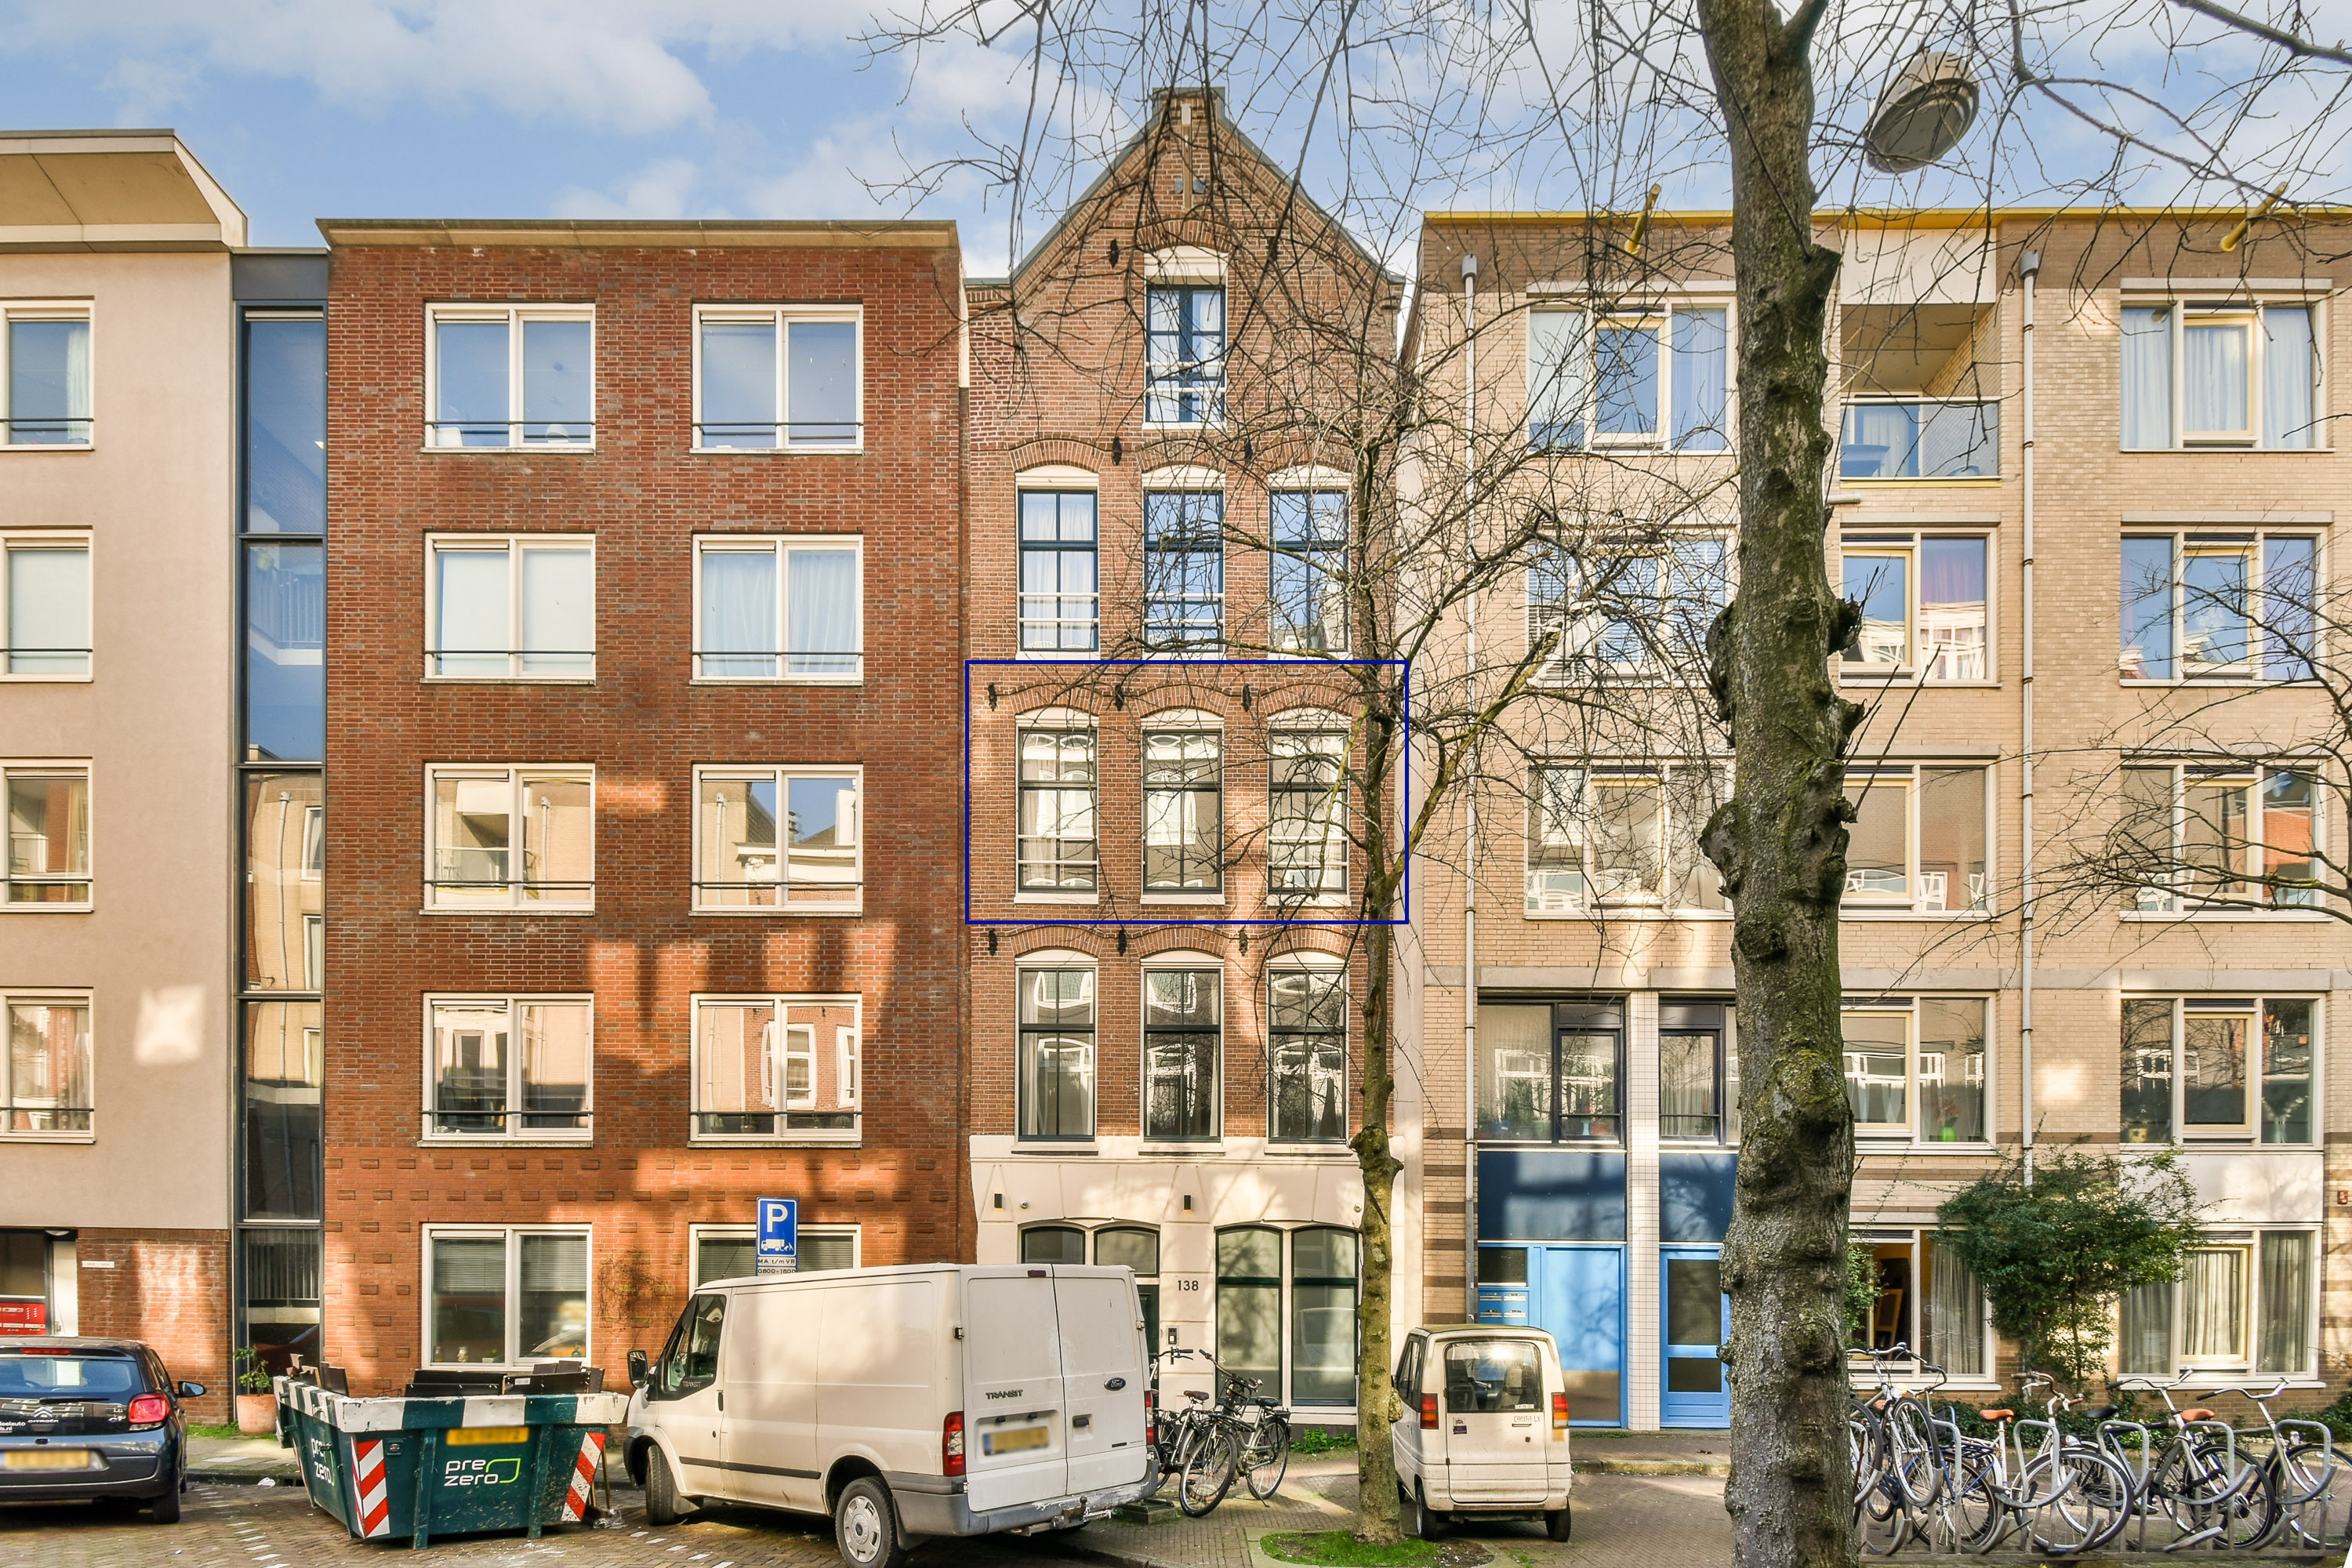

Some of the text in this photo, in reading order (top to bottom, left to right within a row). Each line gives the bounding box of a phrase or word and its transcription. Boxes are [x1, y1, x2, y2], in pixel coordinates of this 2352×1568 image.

[767, 1203, 789, 1232] P
[1178, 1279, 1199, 1291] 138
[1110, 1379, 1123, 1388] Ford
[985, 1389, 1023, 1399] TRANSIT
[314, 1461, 332, 1484] zero
[445, 1459, 486, 1475] pre
[444, 1473, 499, 1486] zero
